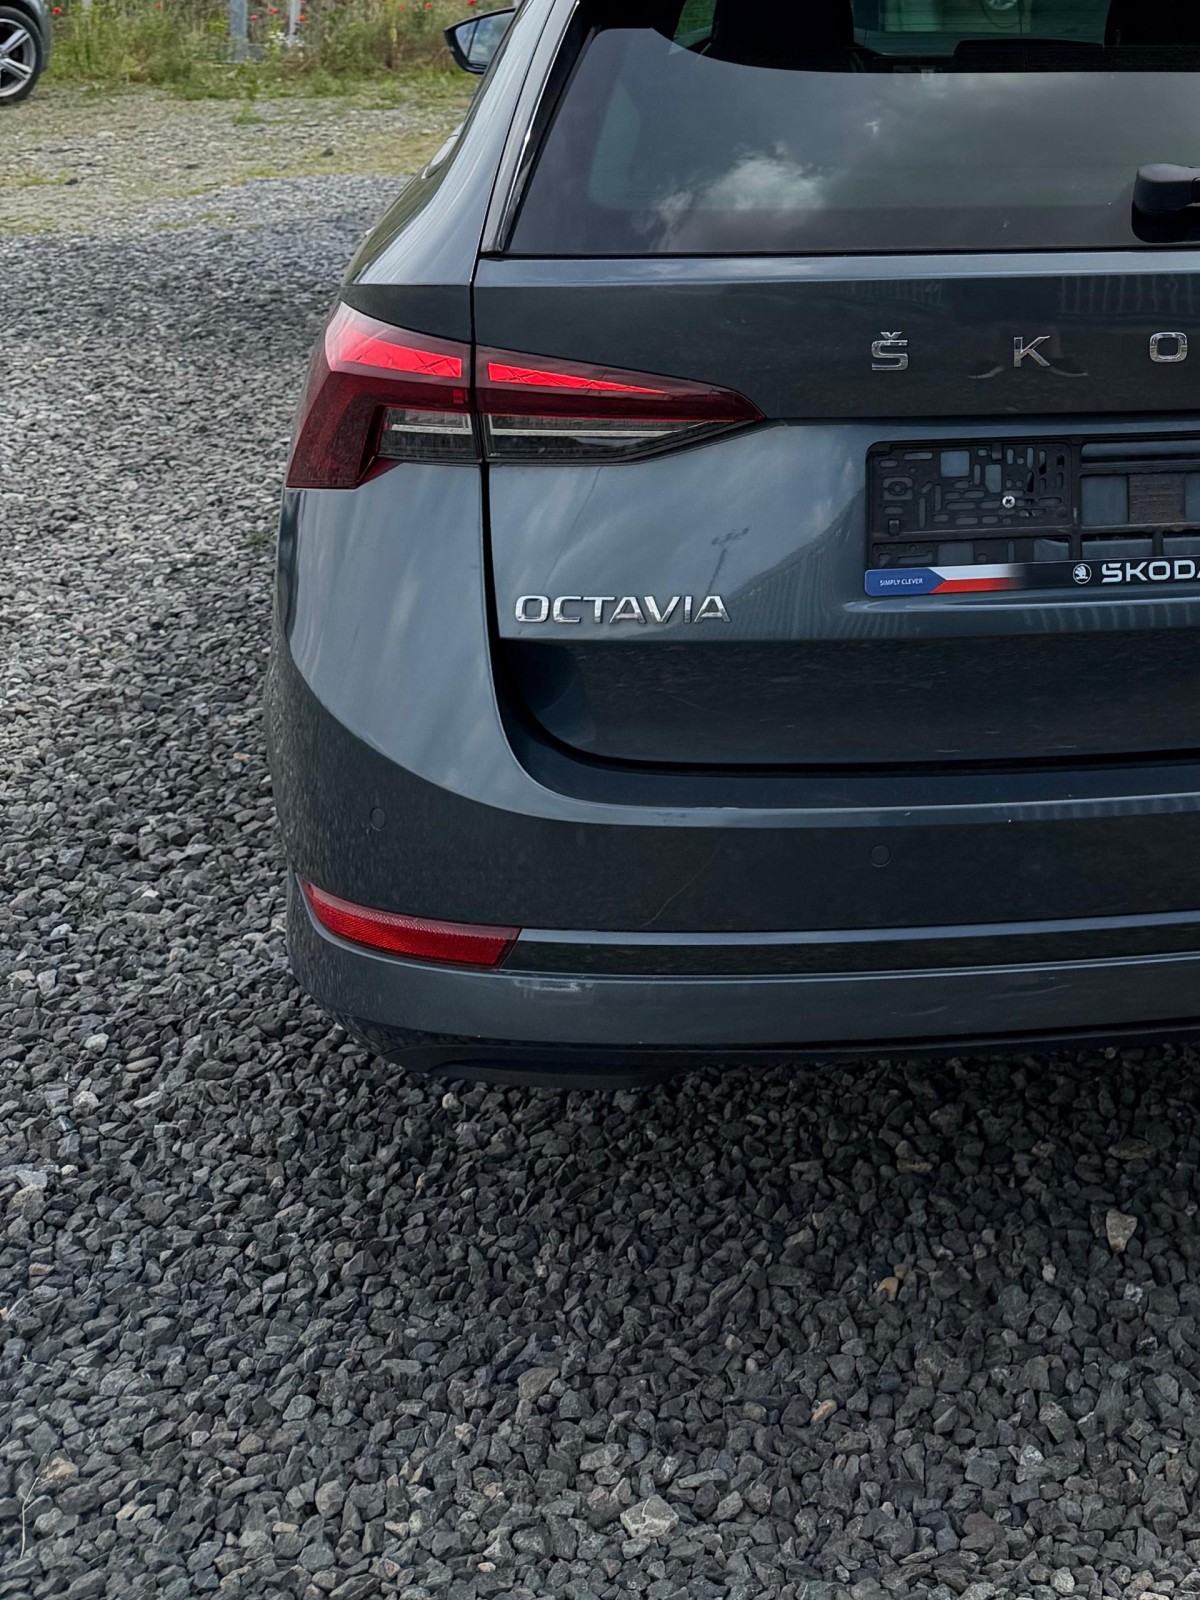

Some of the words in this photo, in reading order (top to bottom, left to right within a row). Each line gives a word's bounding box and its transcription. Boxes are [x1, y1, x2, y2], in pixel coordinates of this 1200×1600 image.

[879, 579, 900, 587] SIMPLY
[901, 577, 923, 585] CLEVER
[514, 595, 731, 624] OCTAVIA
